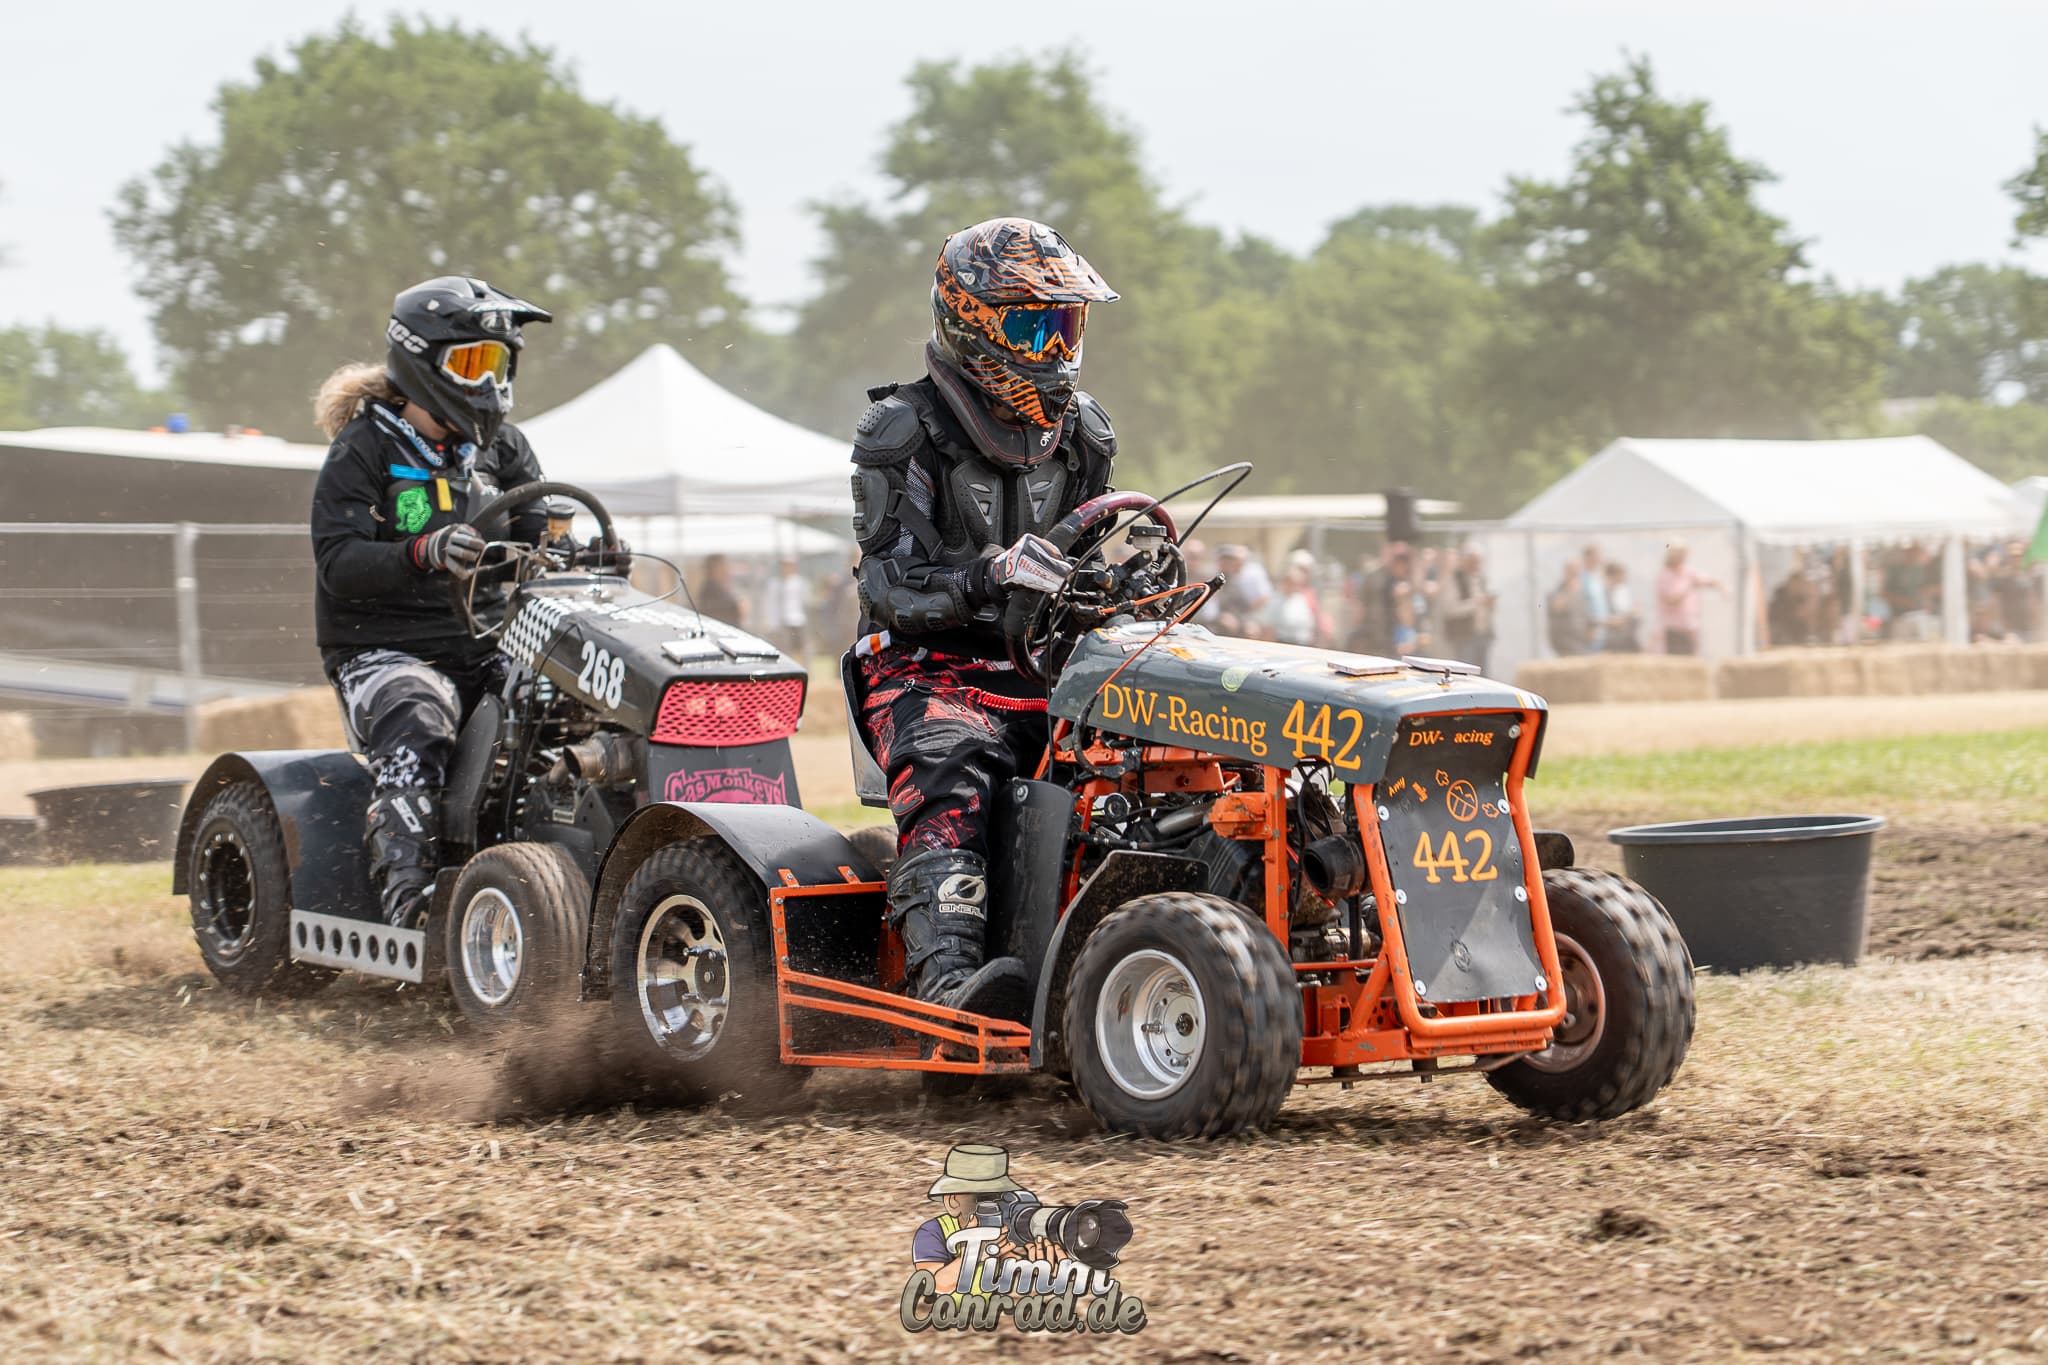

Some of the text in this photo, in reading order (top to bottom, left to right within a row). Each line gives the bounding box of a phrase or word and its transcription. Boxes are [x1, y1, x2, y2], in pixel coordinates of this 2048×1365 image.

[578, 639, 625, 710] 268
[1102, 683, 1364, 771] DW-Racing 442
[1413, 829, 1499, 884] 442
